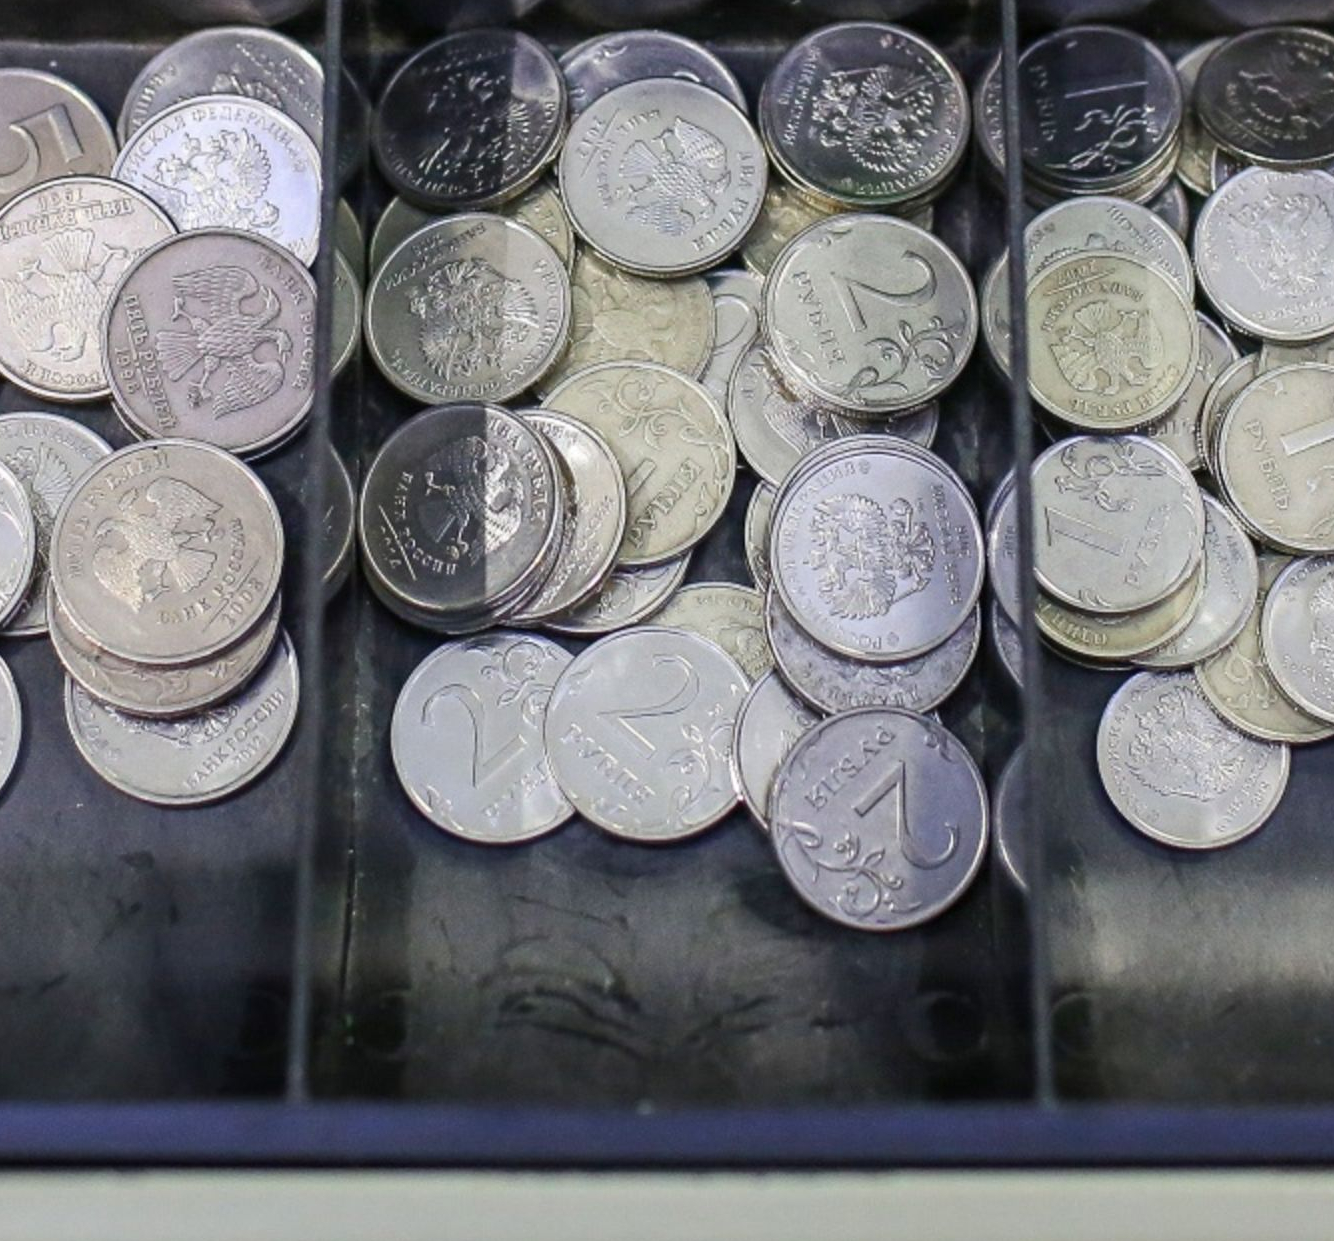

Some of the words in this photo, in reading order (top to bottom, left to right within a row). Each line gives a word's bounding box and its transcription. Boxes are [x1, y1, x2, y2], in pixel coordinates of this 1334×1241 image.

[691, 196, 750, 253] РУБЛЯ
[792, 270, 846, 370] РУБЛЯ
[829, 249, 938, 334] 2
[123, 294, 150, 345] ПЯТЬ
[137, 349, 178, 430] РУБЛЕЙ
[292, 310, 315, 392] РОССИИ
[627, 456, 706, 549] РУБЛЯ
[1243, 417, 1291, 511] РУБЛЬ
[1043, 505, 1129, 558] 1
[1123, 503, 1172, 591] РУБЛЬ
[221, 577, 265, 630] 2008
[183, 749, 229, 791] БАНК
[227, 687, 285, 753] РОССИИ
[420, 682, 531, 790] 2
[597, 653, 700, 762] 2
[560, 722, 656, 802] РУБЛЯ
[804, 725, 896, 811] РУБЛЯ
[853, 759, 960, 871] 2
